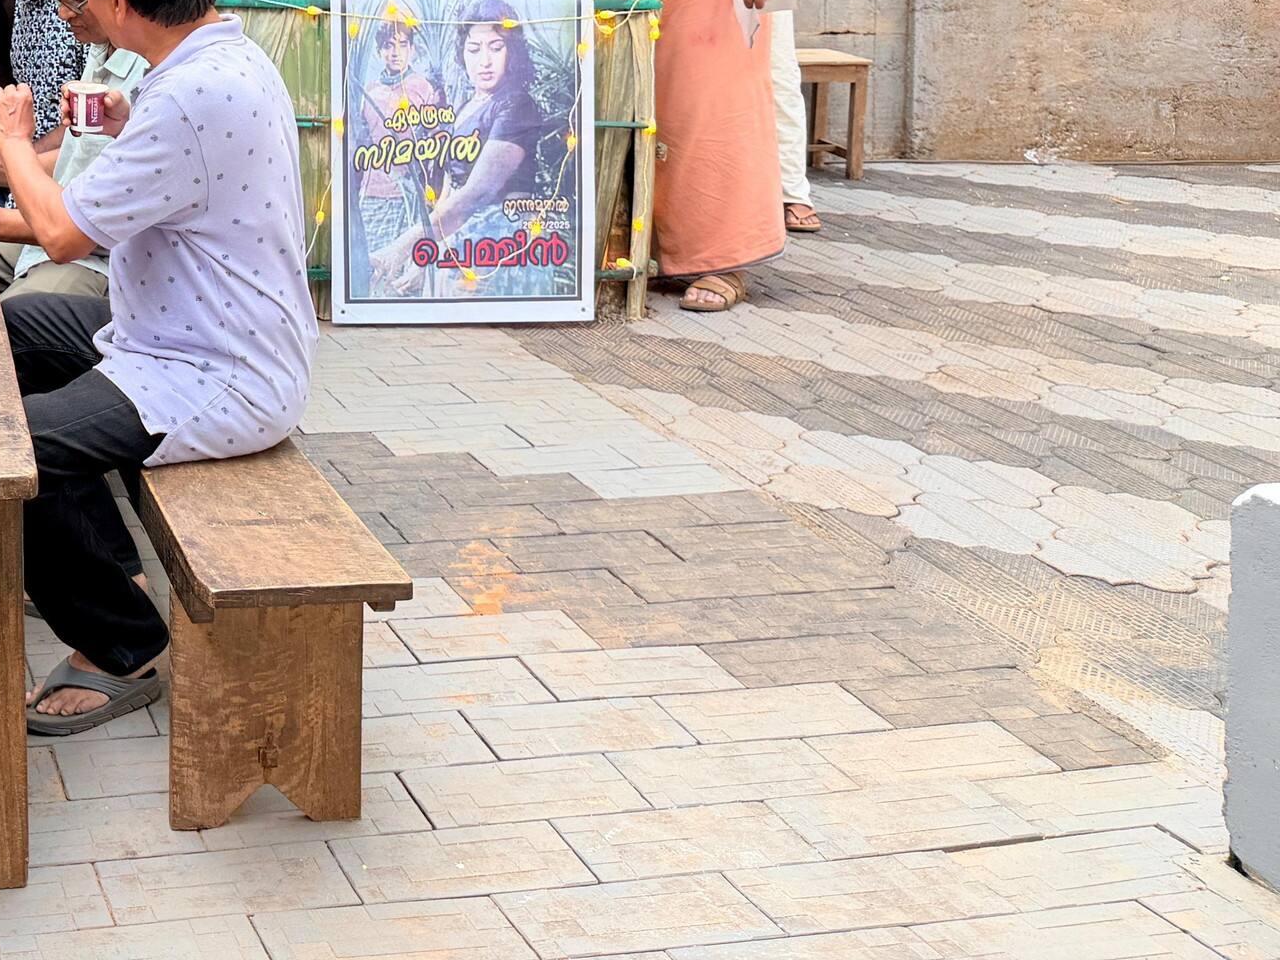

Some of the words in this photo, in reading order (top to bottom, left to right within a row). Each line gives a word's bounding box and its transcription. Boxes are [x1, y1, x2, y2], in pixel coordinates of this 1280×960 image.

[354, 129, 481, 173] സീമയിൽ
[522, 221, 570, 230] 262/2025
[413, 229, 568, 268] ചെമ്മീൻ
